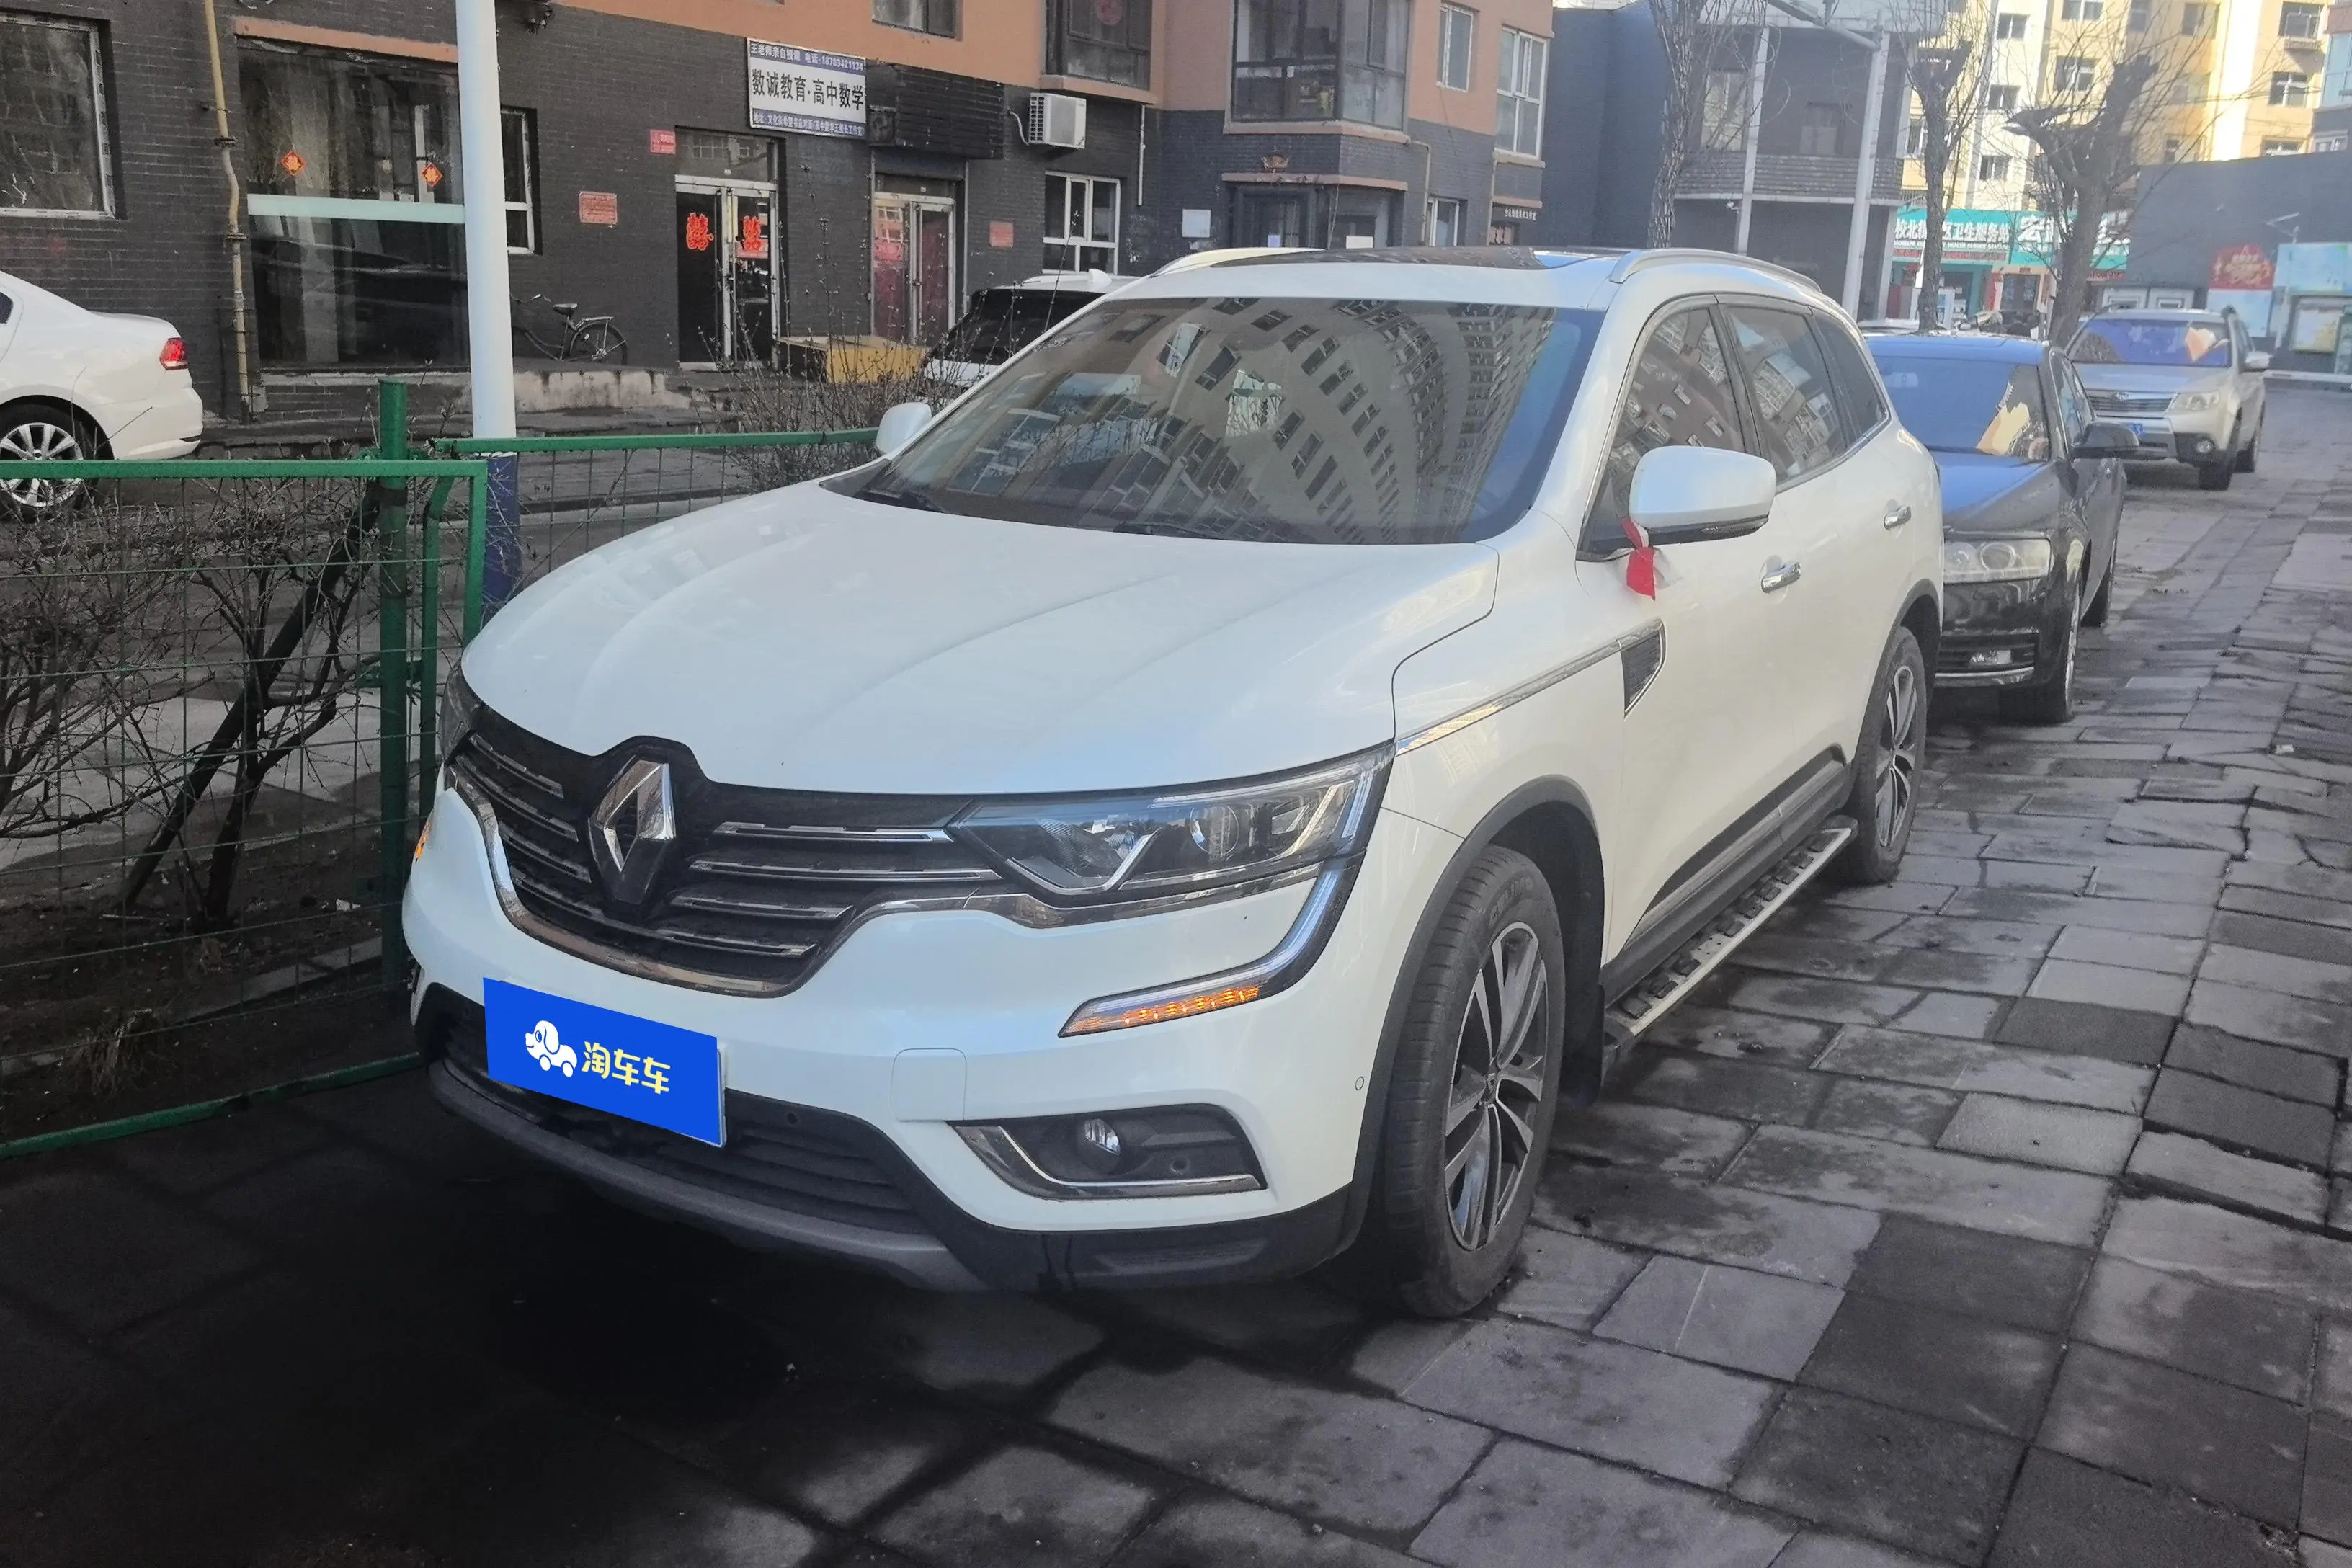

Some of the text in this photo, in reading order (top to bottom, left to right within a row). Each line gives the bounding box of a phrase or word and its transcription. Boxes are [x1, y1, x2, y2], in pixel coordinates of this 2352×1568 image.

[1894, 217, 2010, 244] 校北街区卫生服务站
